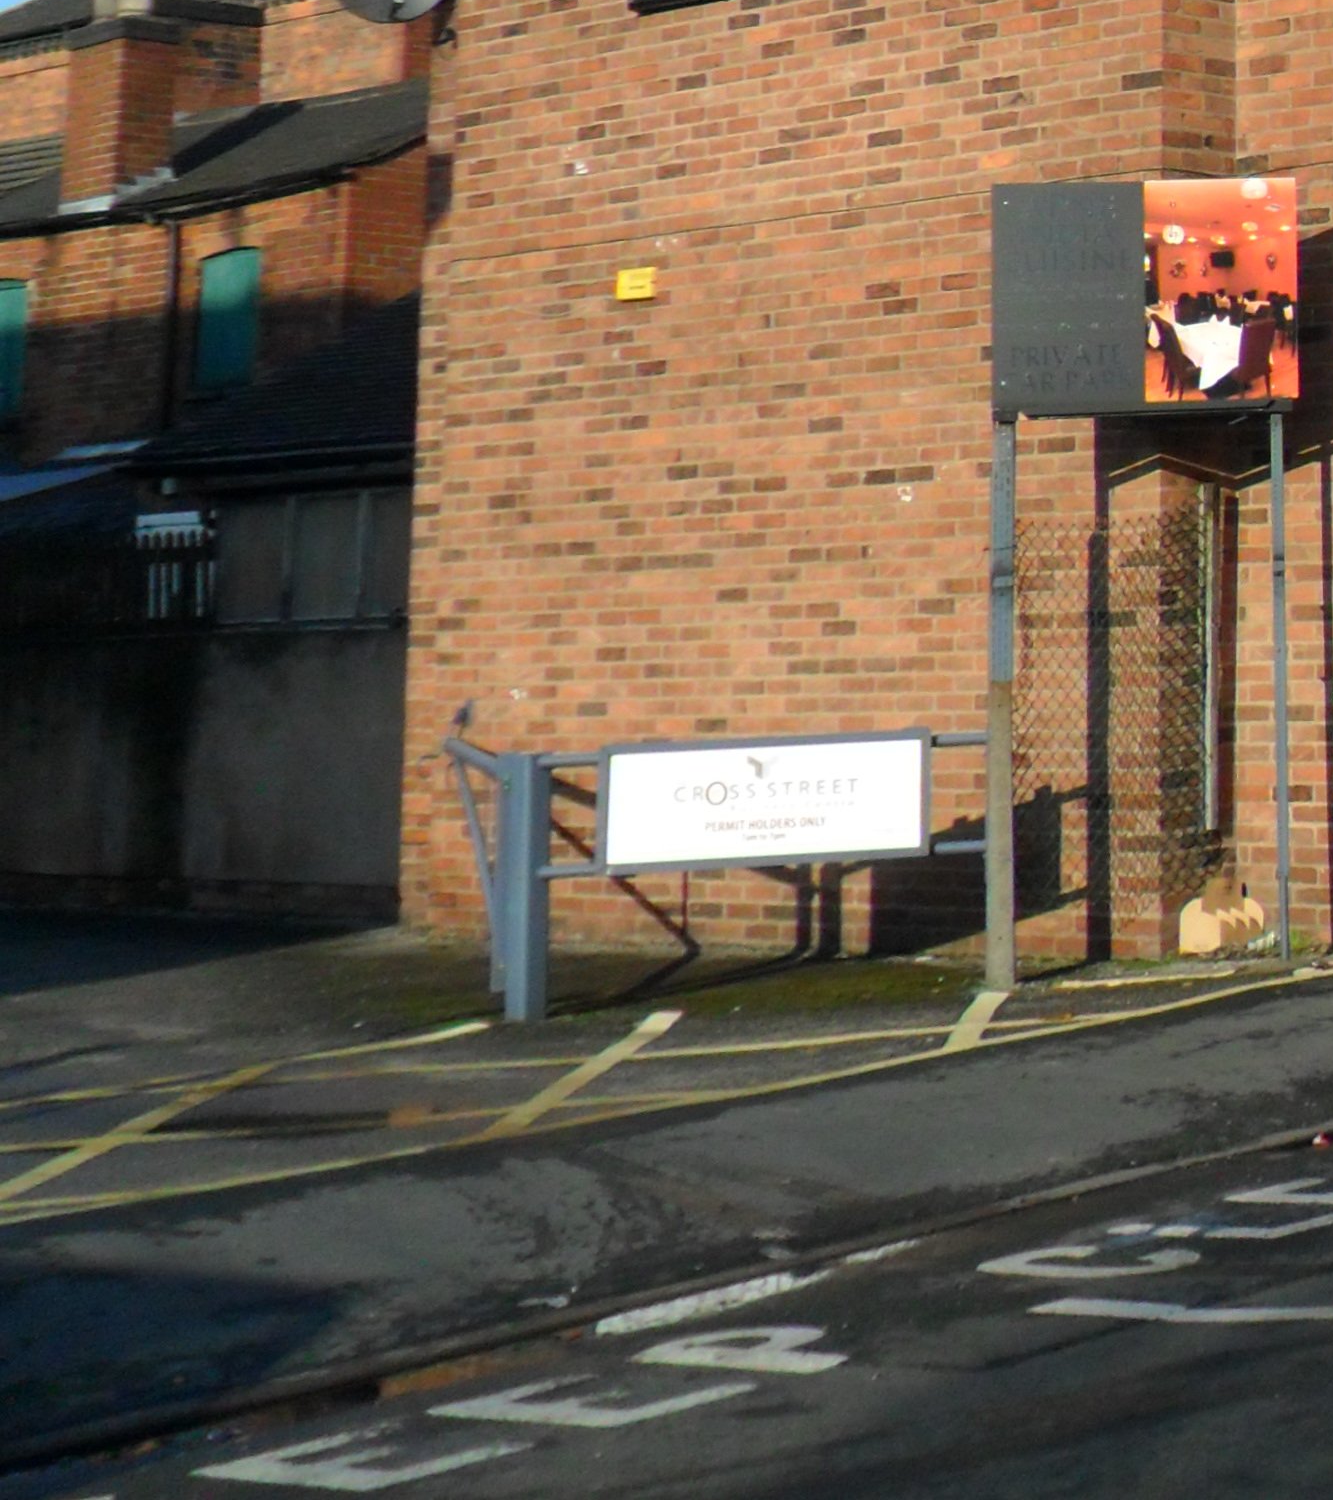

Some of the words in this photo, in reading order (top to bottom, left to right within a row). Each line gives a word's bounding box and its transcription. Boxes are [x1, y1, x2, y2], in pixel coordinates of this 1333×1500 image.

[1010, 343, 1123, 368] PRIVATE
[673, 781, 757, 807] CROSS
[766, 778, 859, 799] STREET
[704, 819, 745, 832] PERMIT
[748, 817, 797, 831] HOLDERS
[799, 815, 827, 829] ONLY
[190, 1324, 850, 1493] EEP
